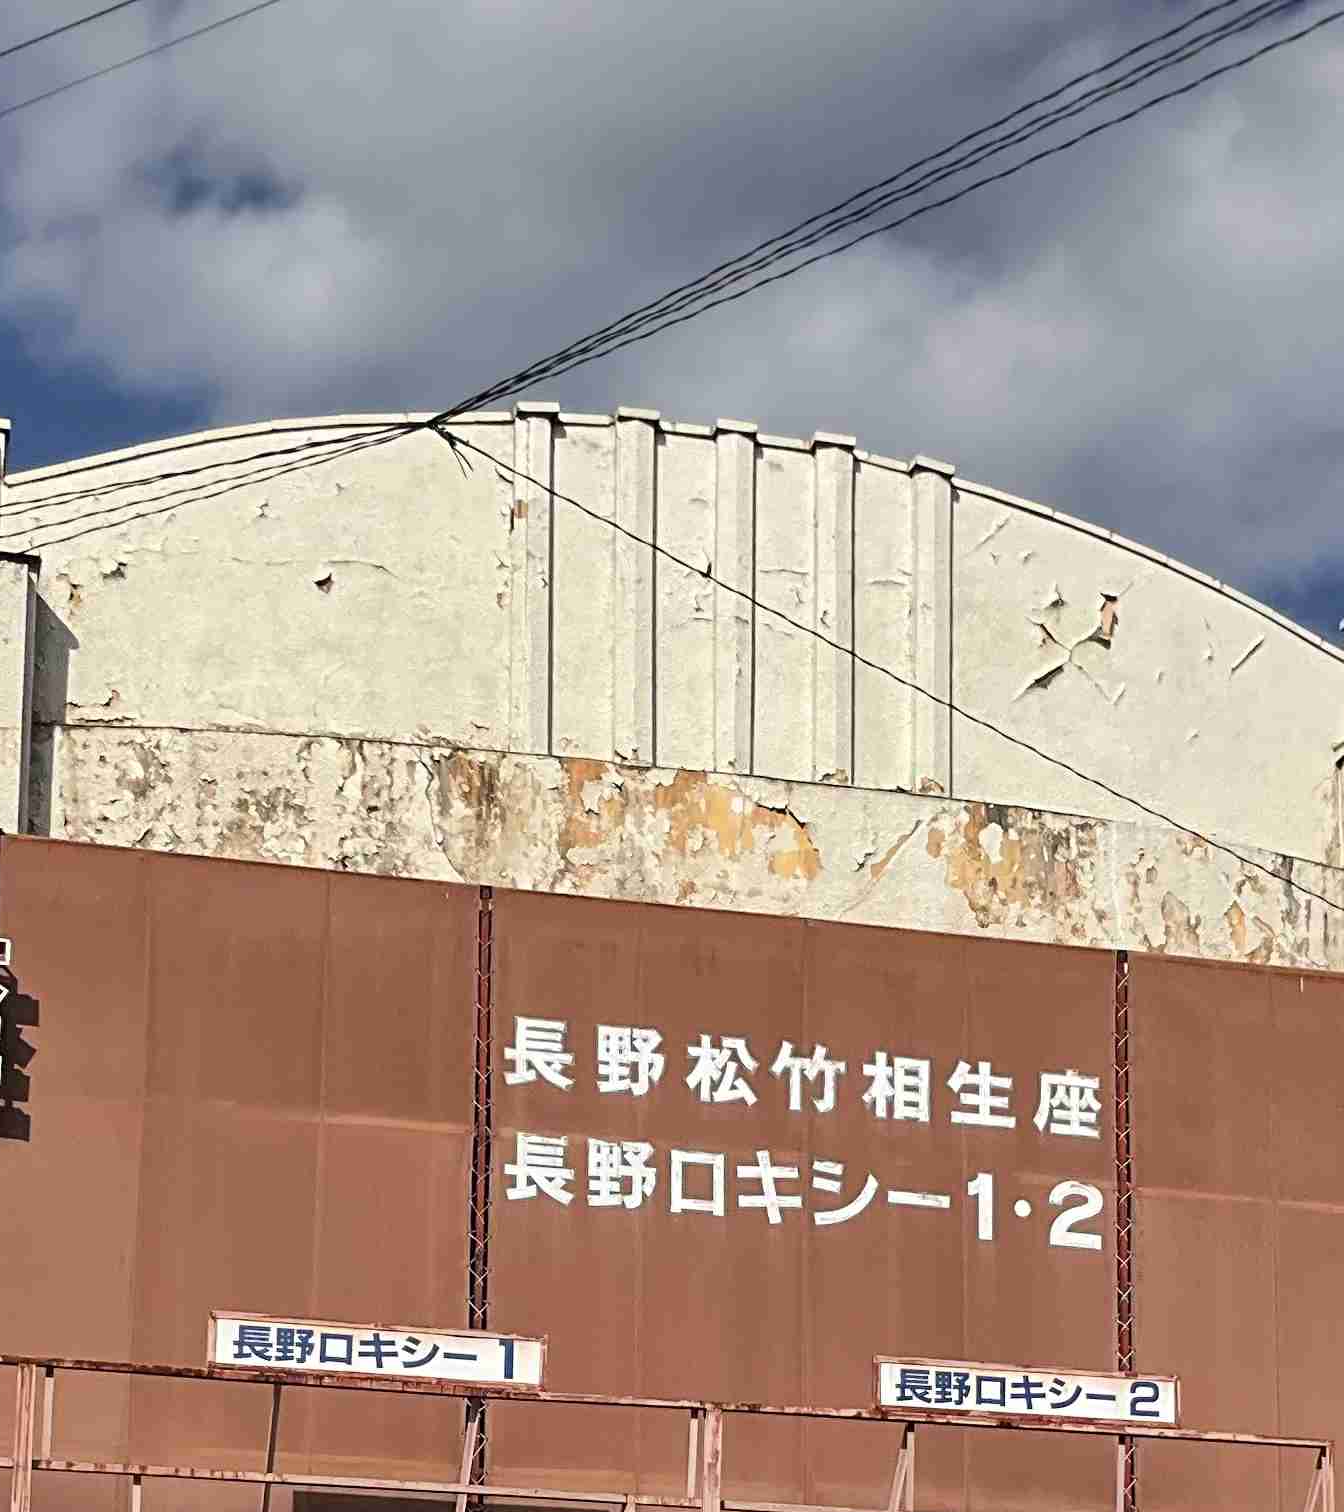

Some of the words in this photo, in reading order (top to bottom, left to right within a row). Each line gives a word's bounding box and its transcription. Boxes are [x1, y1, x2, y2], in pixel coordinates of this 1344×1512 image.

[503, 1016, 1103, 1140] 長野松竹相生座
